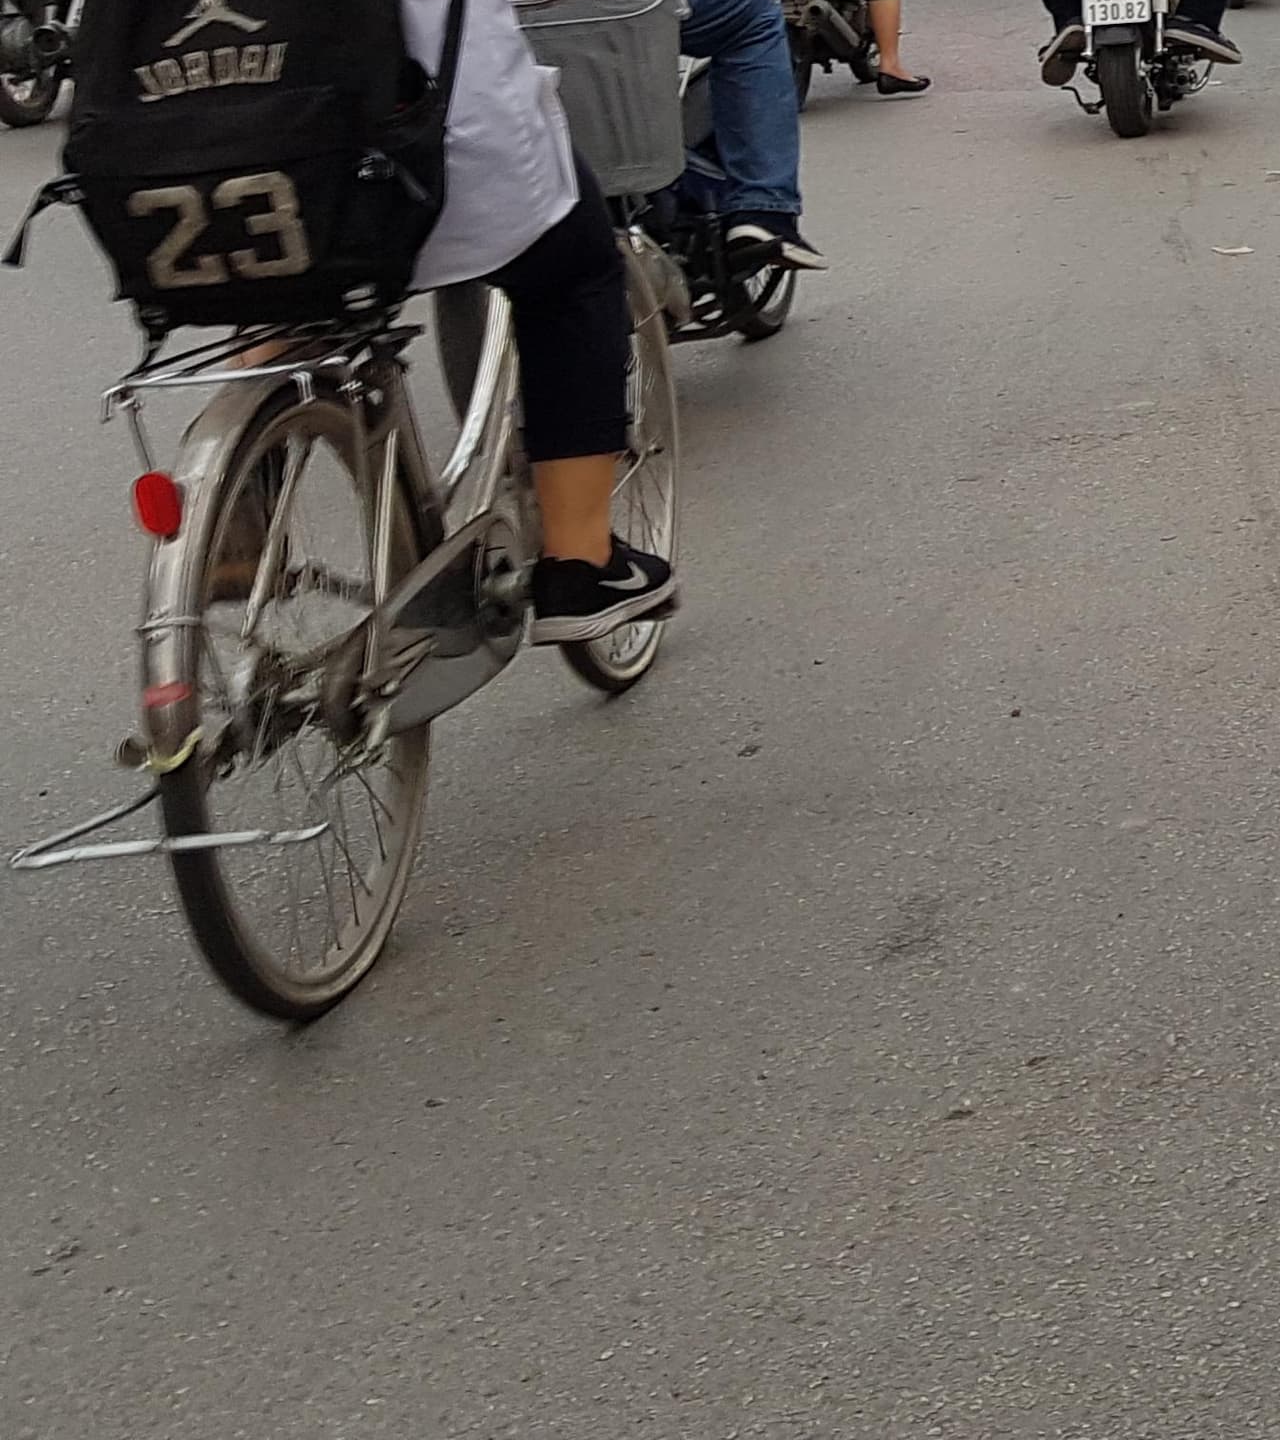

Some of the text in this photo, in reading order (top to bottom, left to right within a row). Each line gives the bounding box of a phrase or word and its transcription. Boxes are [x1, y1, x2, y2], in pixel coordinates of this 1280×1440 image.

[1088, 1, 1146, 22] 130.82
[134, 42, 289, 103] JORDAN
[127, 170, 312, 291] 23
